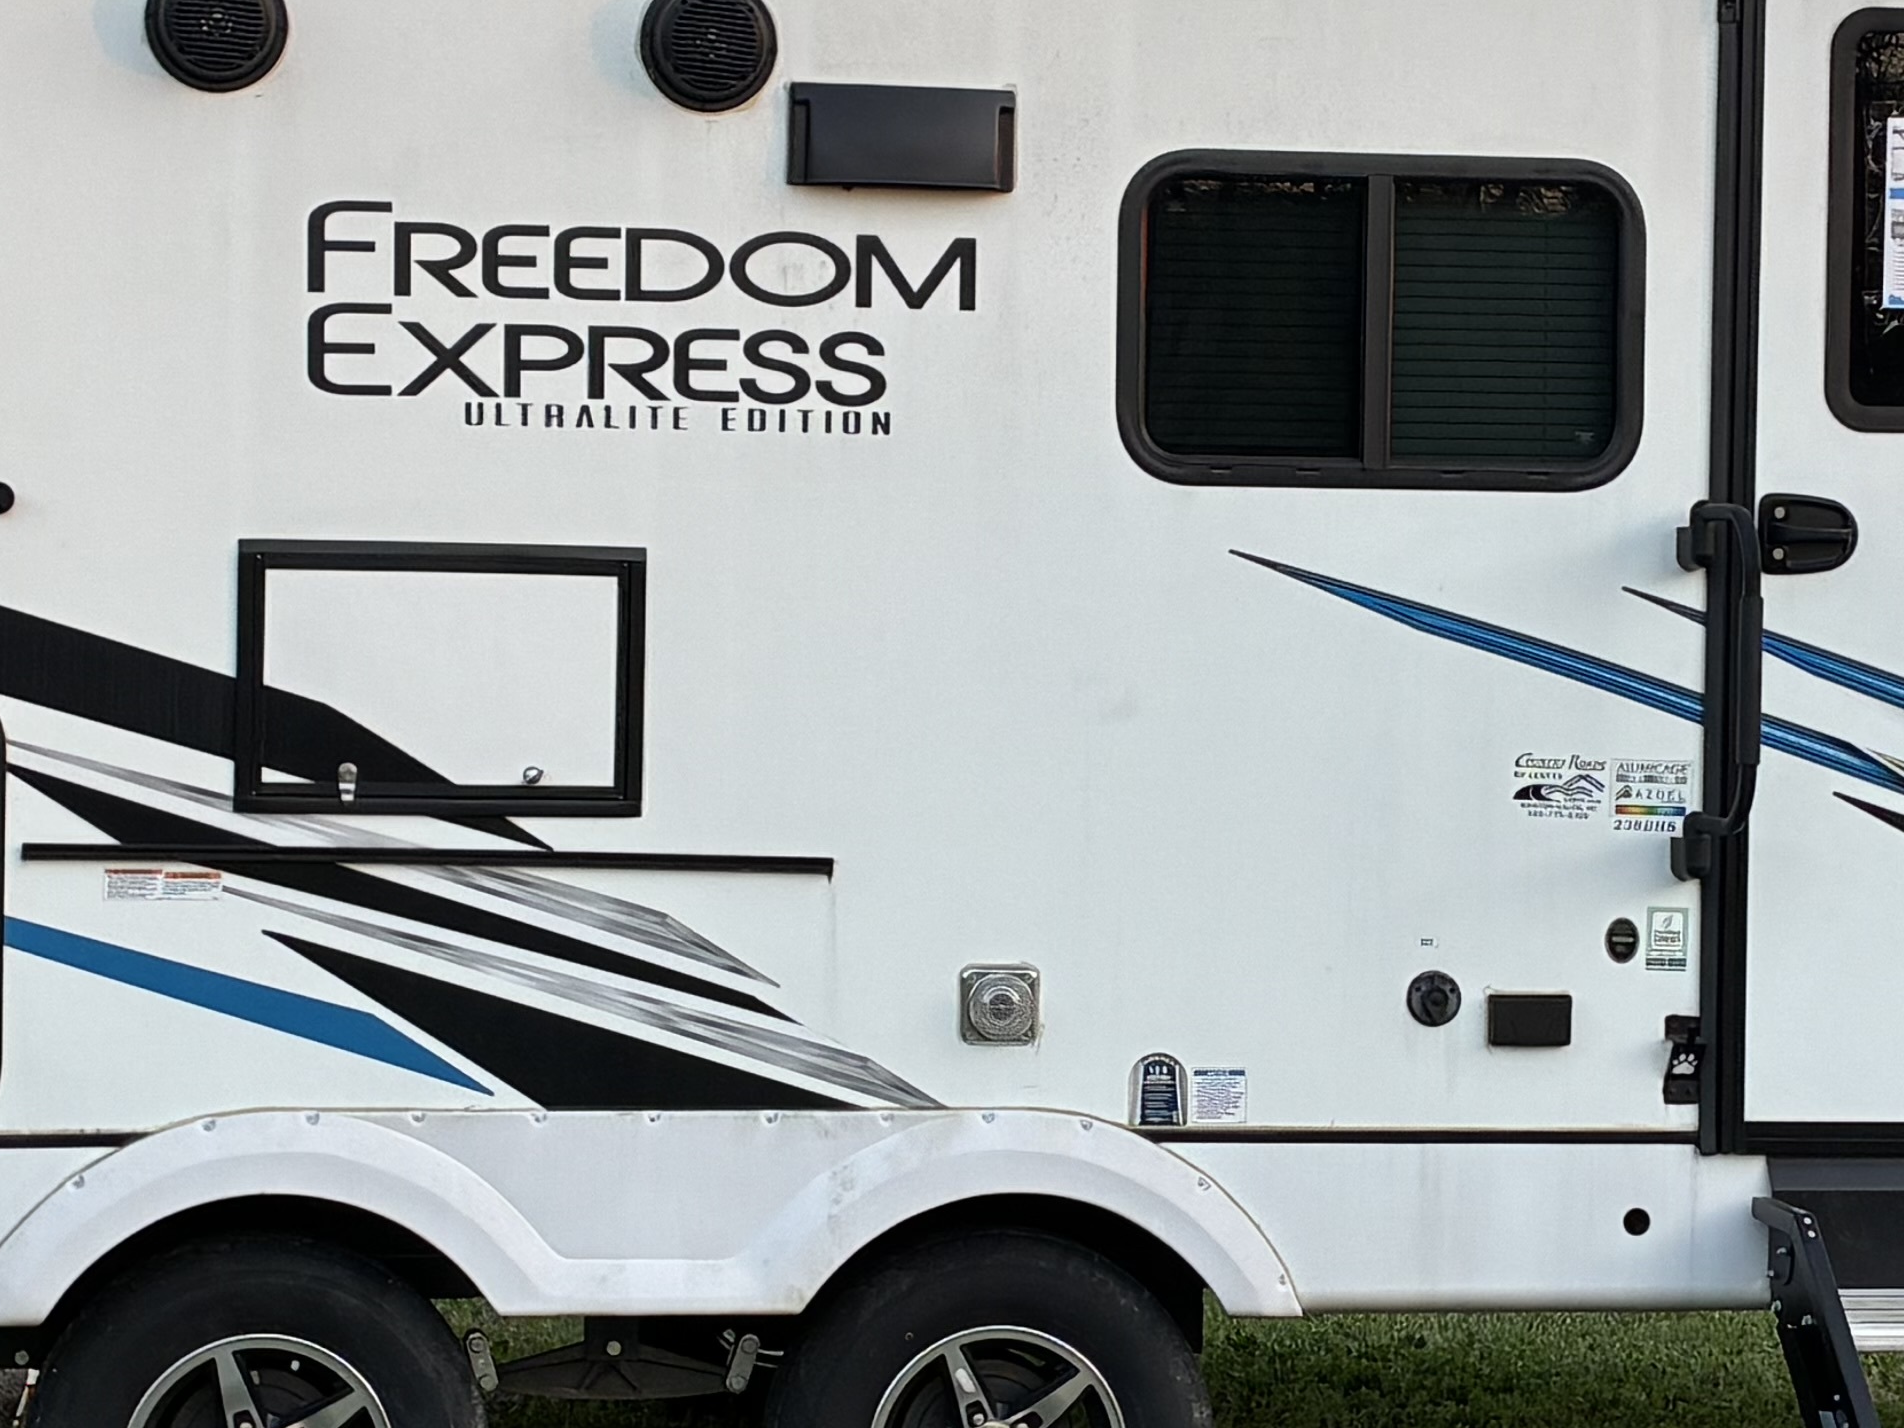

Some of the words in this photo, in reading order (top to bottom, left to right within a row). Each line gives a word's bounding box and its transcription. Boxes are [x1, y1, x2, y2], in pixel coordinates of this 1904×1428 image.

[307, 200, 978, 312] FREEDOM
[307, 302, 887, 407] EXPRESS
[464, 402, 689, 430] ULTRALITE
[721, 407, 892, 435] EDITION
